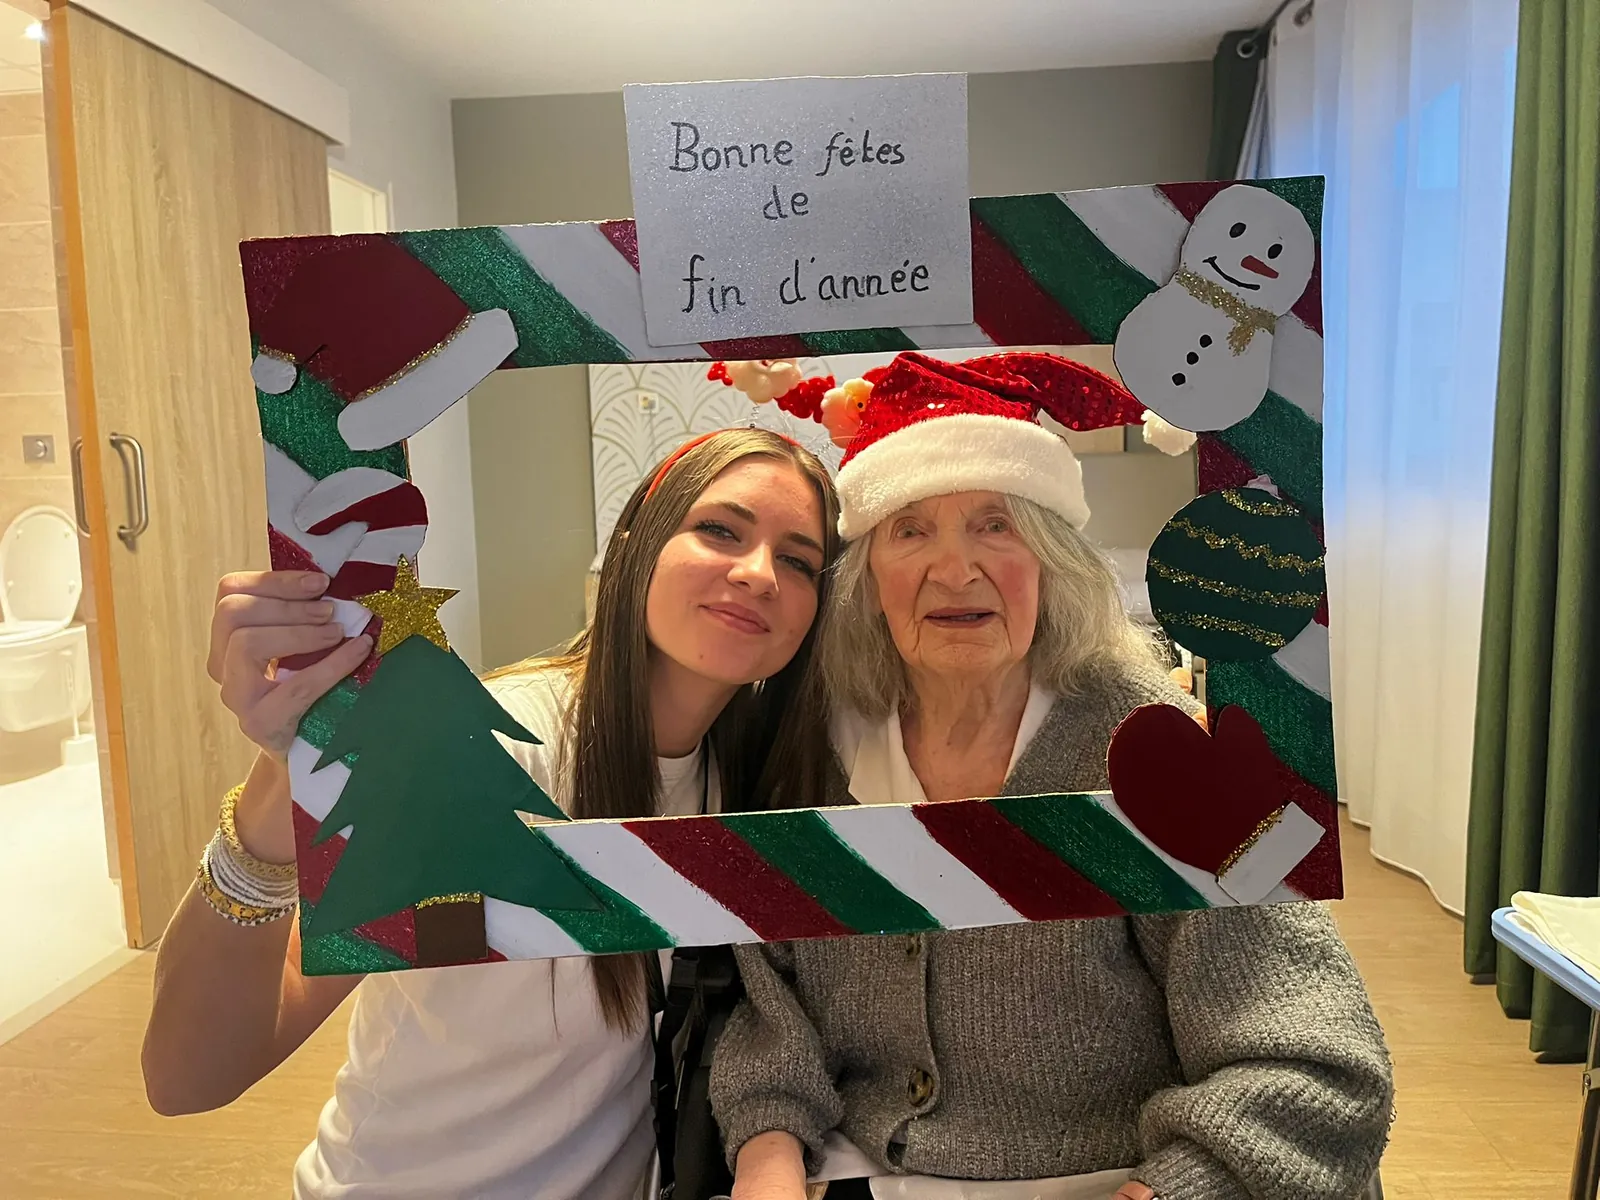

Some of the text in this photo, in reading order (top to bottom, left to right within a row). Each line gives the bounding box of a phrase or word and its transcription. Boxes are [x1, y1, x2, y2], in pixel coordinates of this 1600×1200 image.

[669, 121, 905, 177] Bonne fêtes
[763, 185, 809, 220] de
[682, 254, 930, 314] fin d'année
